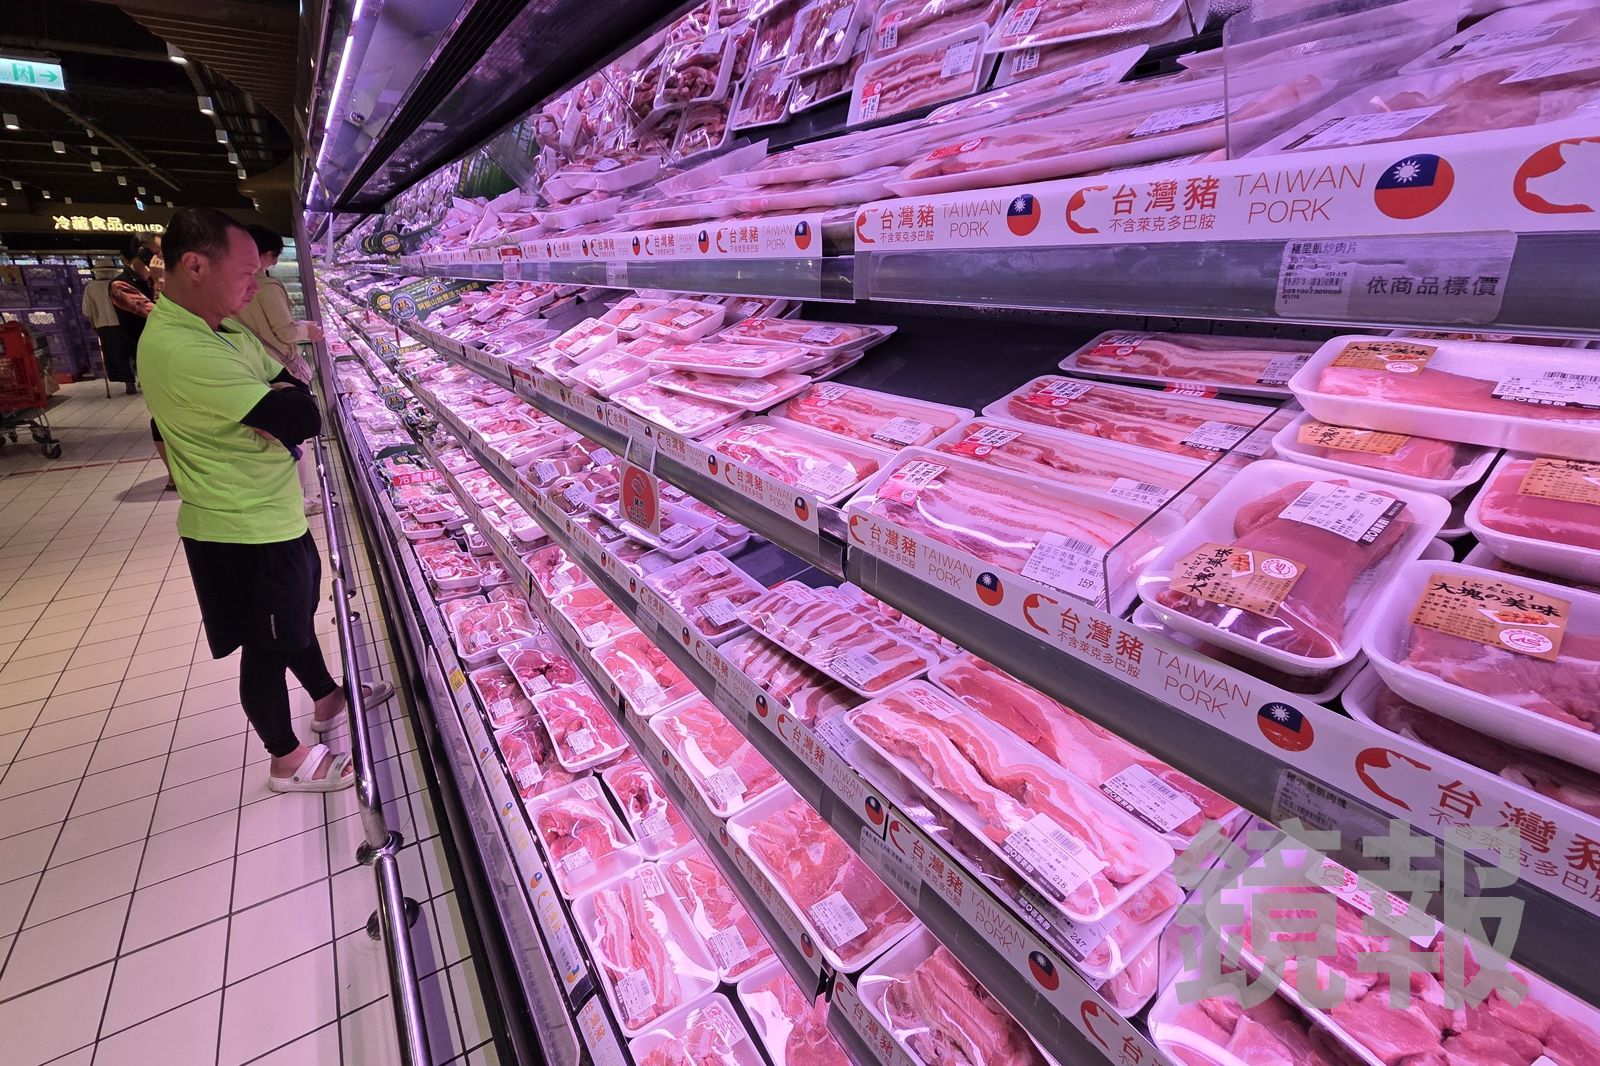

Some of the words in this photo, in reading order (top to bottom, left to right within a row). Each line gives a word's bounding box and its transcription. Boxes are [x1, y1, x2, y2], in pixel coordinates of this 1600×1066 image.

[1234, 163, 1366, 198] TAIWAN
[1112, 175, 1220, 216] 台灣豬
[52, 215, 124, 231] 冷藏食品
[880, 204, 935, 231] 台灣豬
[942, 199, 1002, 220] TAIWAN
[1108, 213, 1216, 233] 不含萊克多巴胺
[1247, 196, 1335, 225] PORK
[123, 223, 163, 233] CHILLED
[654, 233, 675, 248] 台灣豬
[729, 225, 759, 244] 台灣豬
[761, 224, 793, 237] TAIWAN
[879, 230, 935, 243] 不含萊克多巴胺
[949, 221, 989, 238] PORK
[766, 238, 788, 251] PORK
[1366, 276, 1500, 297] 依商品標價
[737, 463, 764, 490] 台灣豬
[765, 480, 793, 500] TAIWAN
[769, 491, 789, 511] PORK
[869, 522, 917, 558] 台灣豬
[869, 542, 917, 570] 不含萊克多巴胺
[921, 544, 974, 579] TAIWAN
[928, 563, 963, 590] PORK
[1078, 577, 1094, 589] 159
[1186, 547, 1234, 596] 大塊の美味
[1429, 581, 1562, 618] 大塊の美味
[1060, 606, 1146, 665] 台灣豬
[1056, 629, 1142, 681] 不含萊克多巴胺
[1154, 647, 1253, 709] TAIWAN
[1163, 675, 1229, 720] PORK
[792, 725, 827, 762] 台灣豬
[827, 756, 865, 799] TAIWAN
[831, 774, 857, 803] PORK
[912, 839, 964, 897] 台灣豬
[1052, 875, 1068, 890] 218
[968, 890, 1027, 950] TAIWAN
[975, 911, 1013, 954] PORK
[1069, 932, 1087, 948] 247
[854, 1003, 894, 1059] 台灣豬
